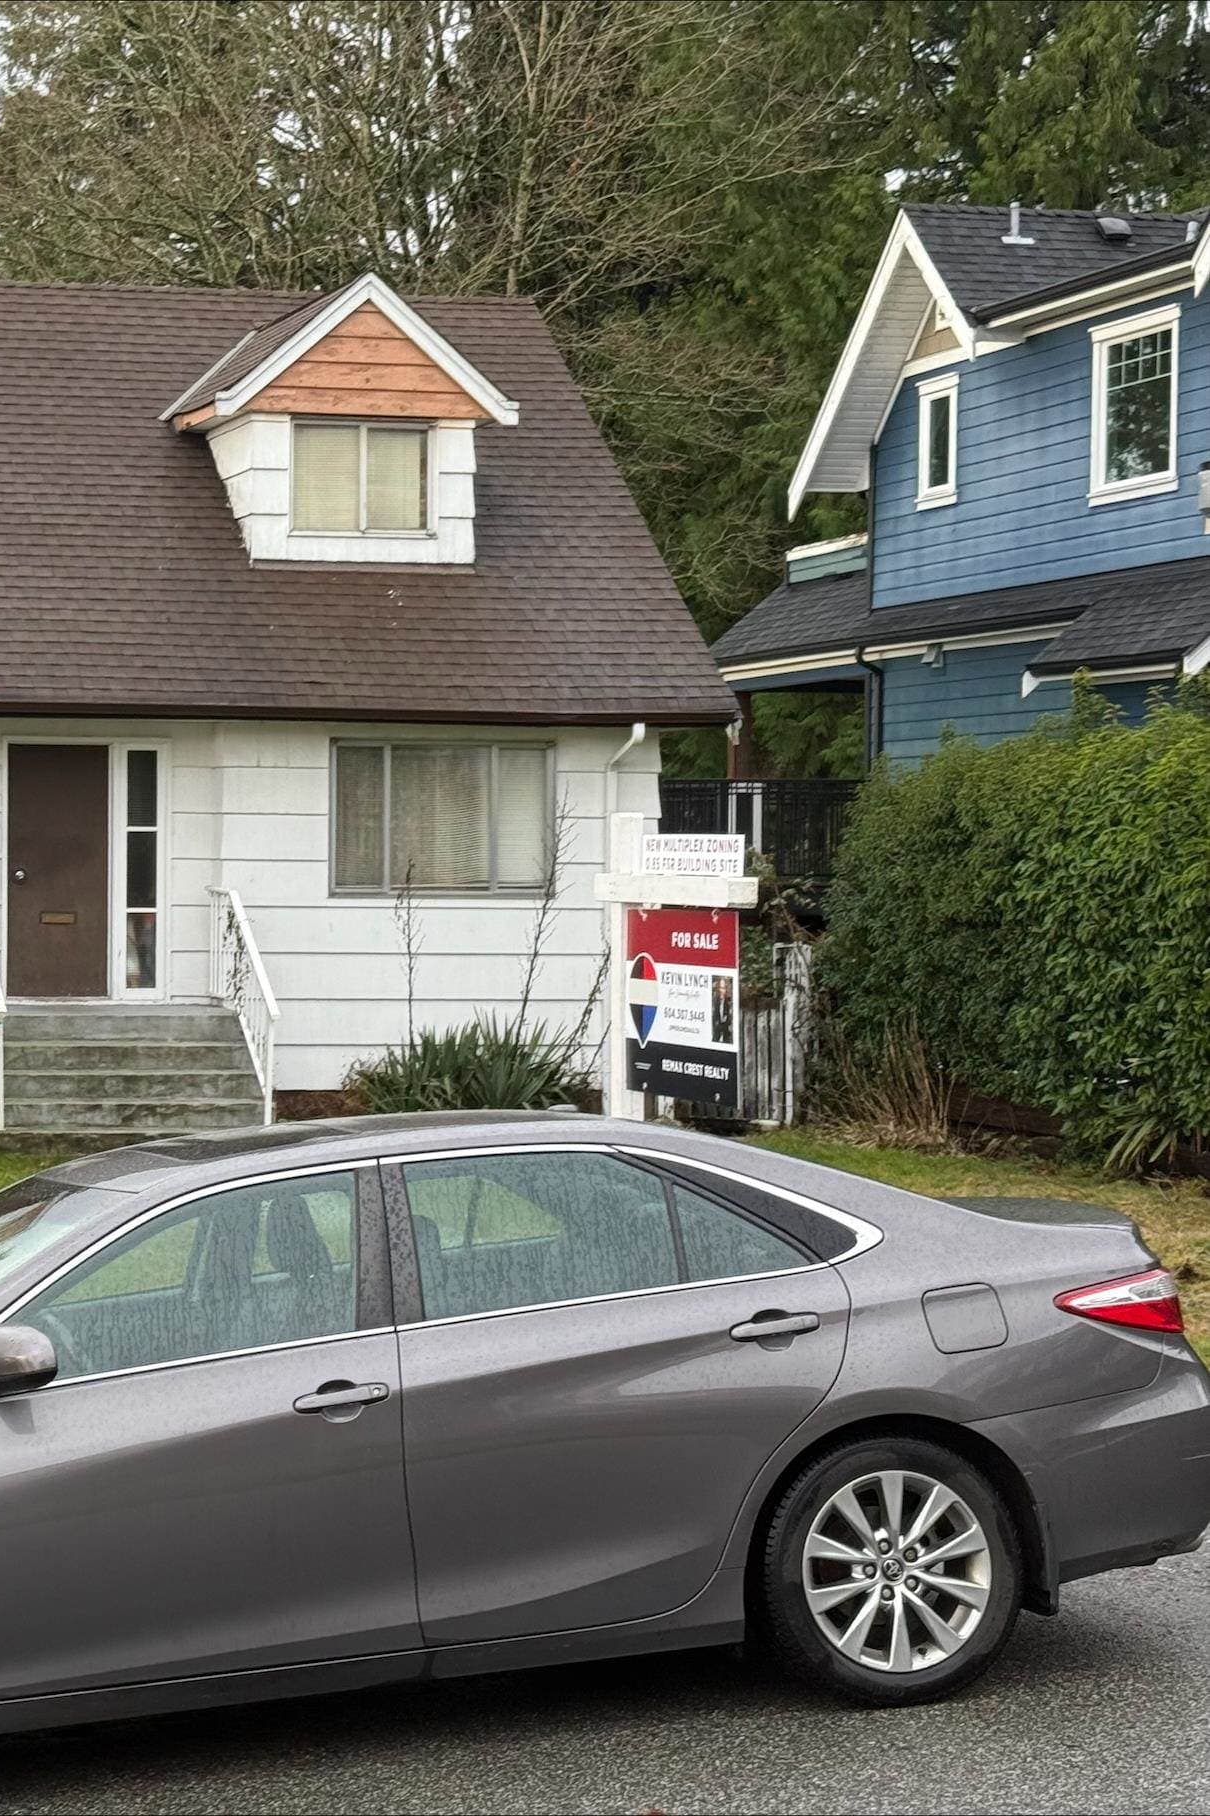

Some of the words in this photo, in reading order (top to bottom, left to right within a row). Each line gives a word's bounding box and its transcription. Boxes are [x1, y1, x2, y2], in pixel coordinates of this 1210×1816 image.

[646, 839, 661, 852] NEW
[663, 839, 704, 853] MULTIPLEX
[707, 839, 739, 853] ZONING
[663, 857, 675, 871] FSR
[677, 858, 717, 872] BUILDING
[719, 858, 738, 873] SITE
[671, 931, 691, 948] FOR
[693, 932, 719, 950] SALE
[661, 971, 682, 985] KEVIN
[684, 973, 709, 988] LYNCH
[684, 1062, 703, 1077] CREST
[704, 1065, 730, 1081] REALTY
